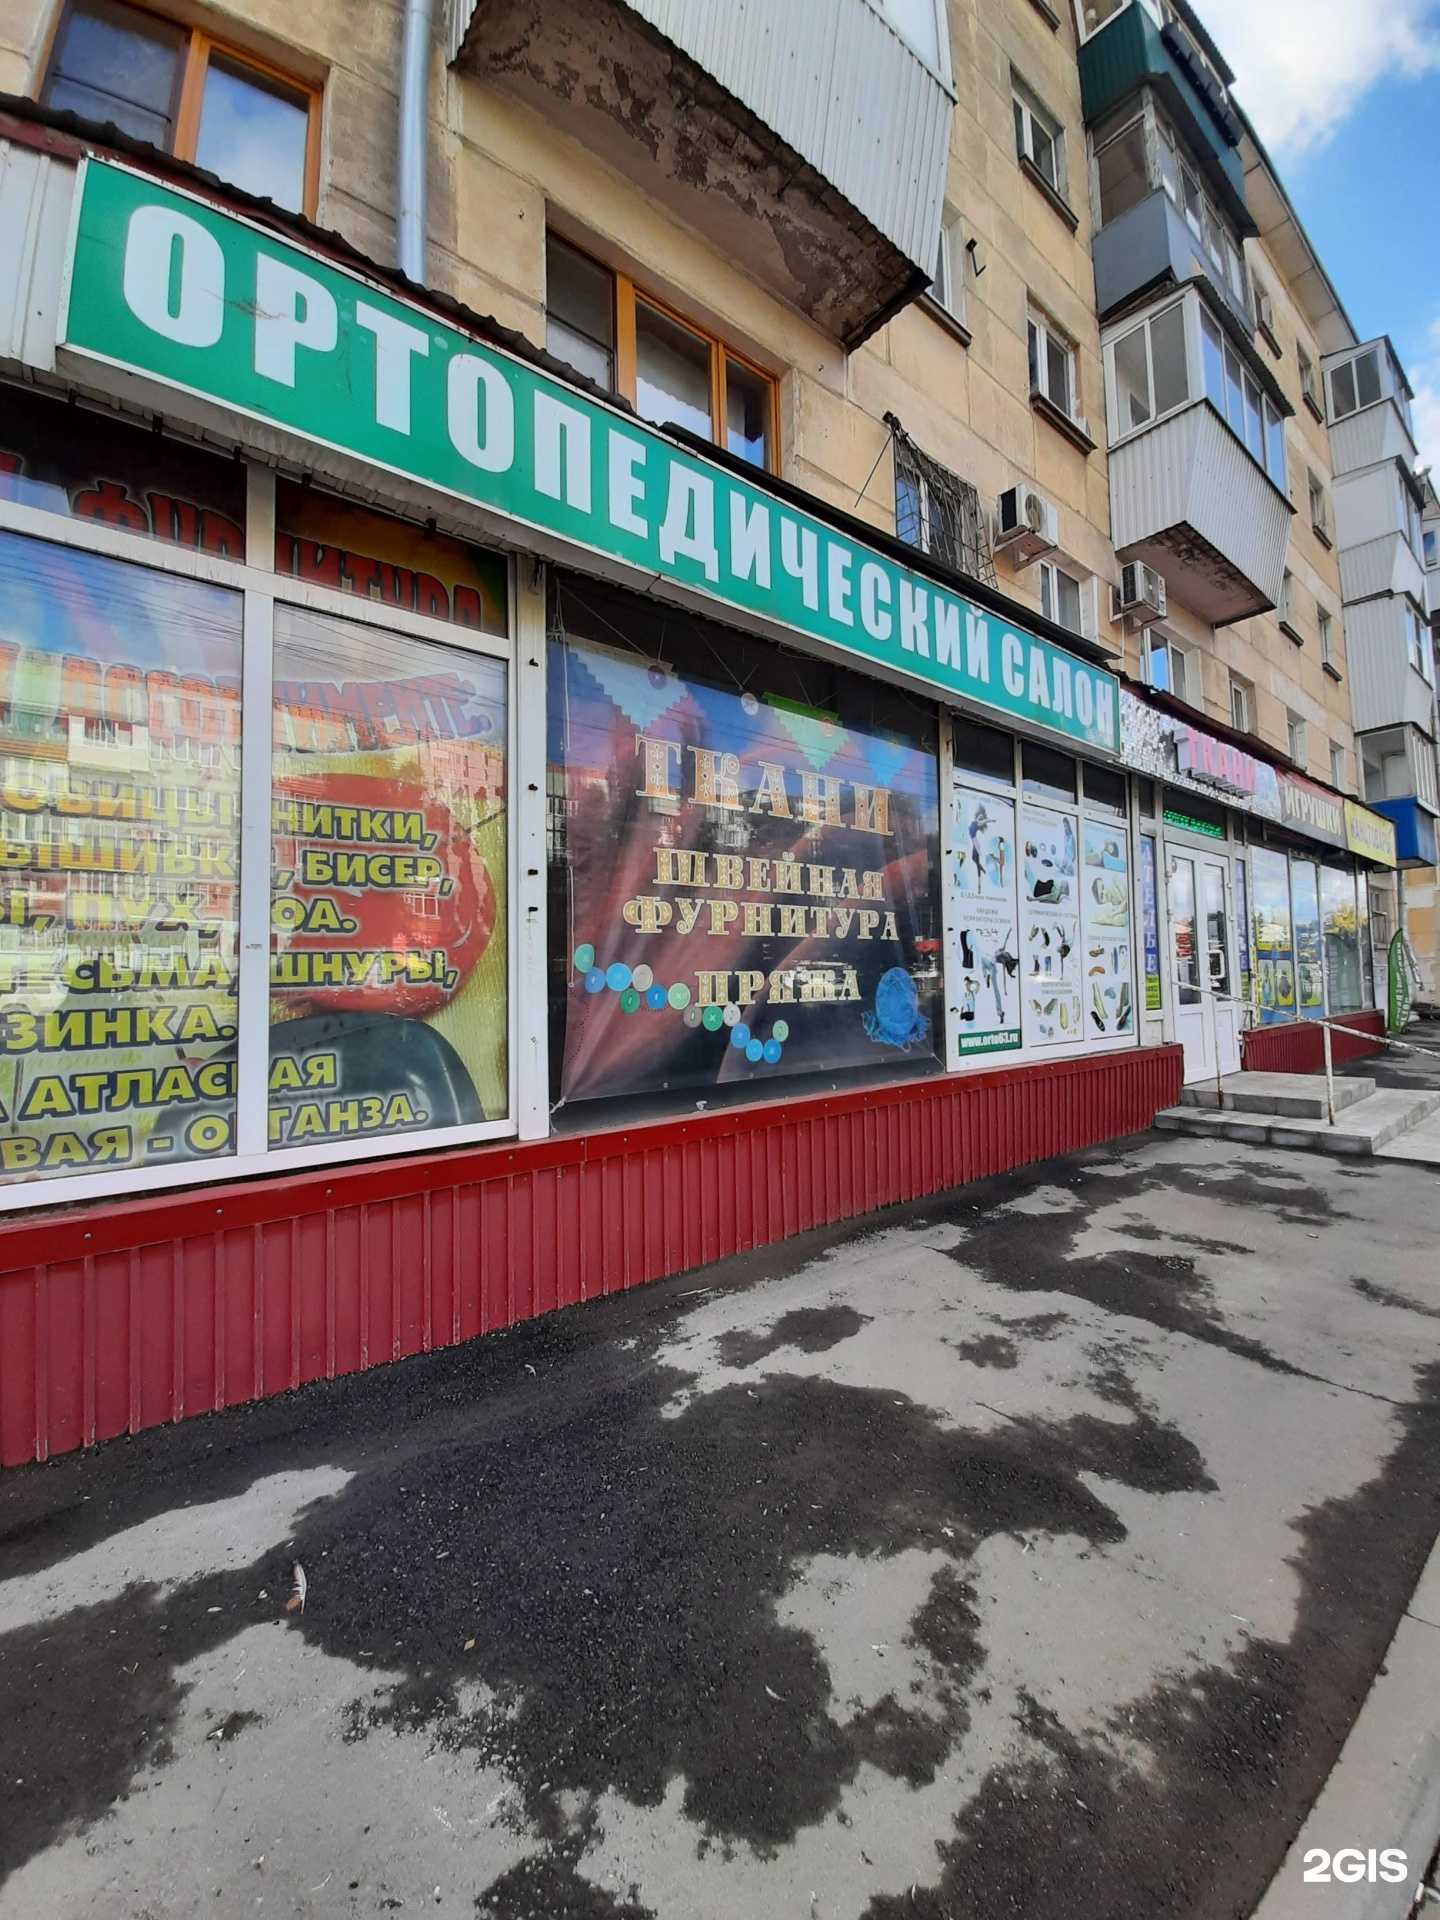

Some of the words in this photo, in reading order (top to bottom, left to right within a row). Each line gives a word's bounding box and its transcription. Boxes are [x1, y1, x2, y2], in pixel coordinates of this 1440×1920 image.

[123, 205, 990, 684] ОРТОПЕДИЧЕСКИЙ
[1001, 632, 1113, 747] САЛОН
[634, 733, 895, 836] ТКАНИ
[1285, 784, 1341, 836] ИГРУШКИ
[302, 849, 455, 897] БИСЕР,
[652, 847, 886, 902] ШВЕЙНАЯ
[622, 895, 900, 941] ФУРНИТУРА
[694, 968, 862, 1008] ПРЯЖА
[18, 1053, 337, 1121] АТЛАСАЯ
